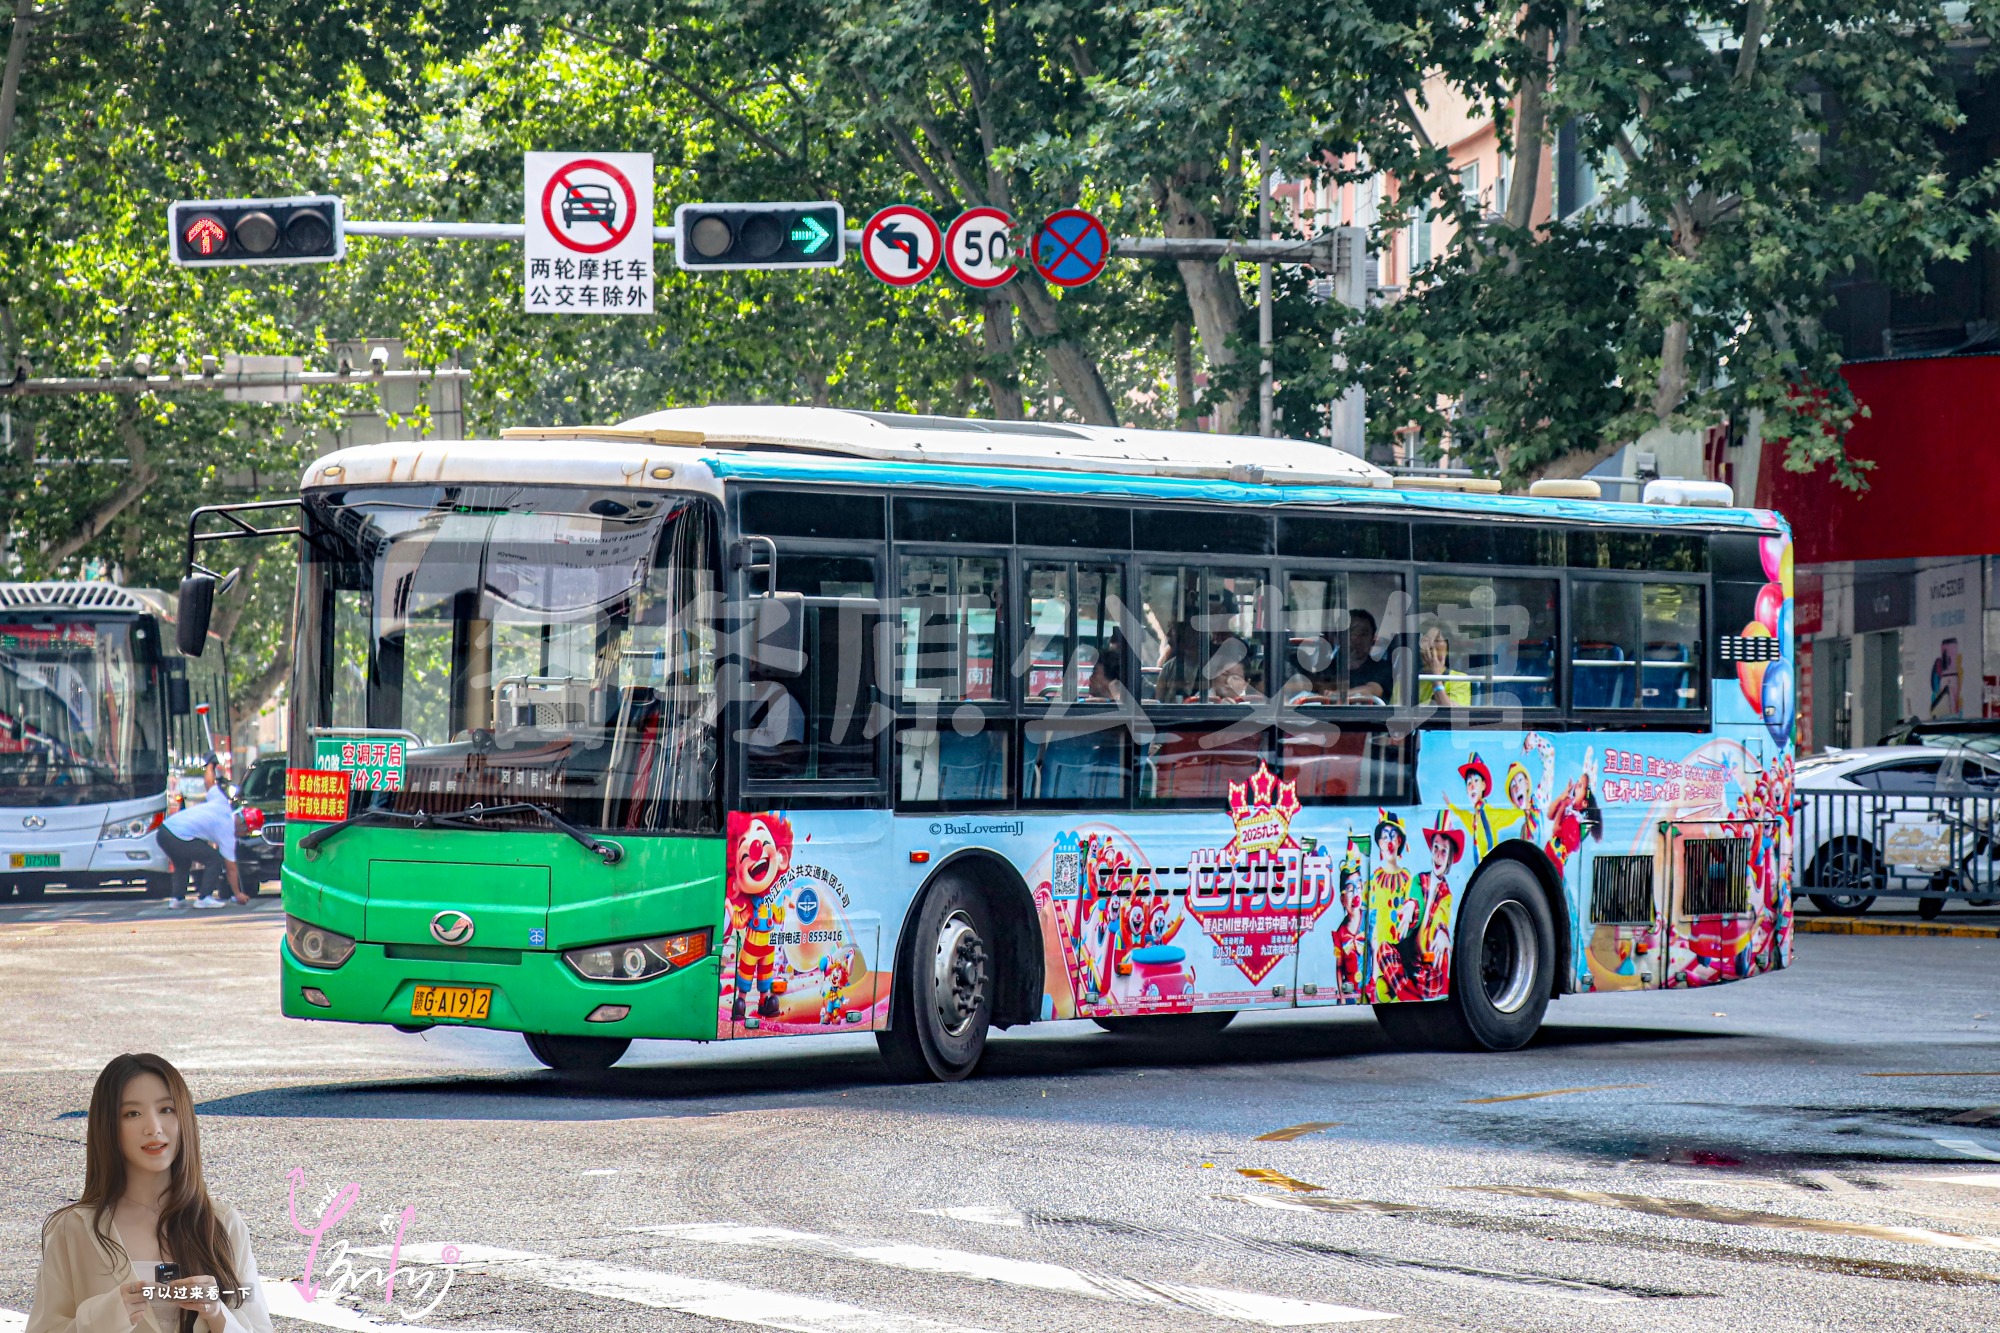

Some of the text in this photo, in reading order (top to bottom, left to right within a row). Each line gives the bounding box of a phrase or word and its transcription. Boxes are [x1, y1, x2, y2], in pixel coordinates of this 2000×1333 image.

[965, 230, 1008, 267] 50
[530, 257, 648, 281] 两轮摩托车
[530, 284, 648, 307] 公交车除外
[341, 742, 402, 767] 空调开启
[764, 864, 851, 909] 九江市公共交通集团公司
[1188, 848, 1332, 908] 世界小丑节
